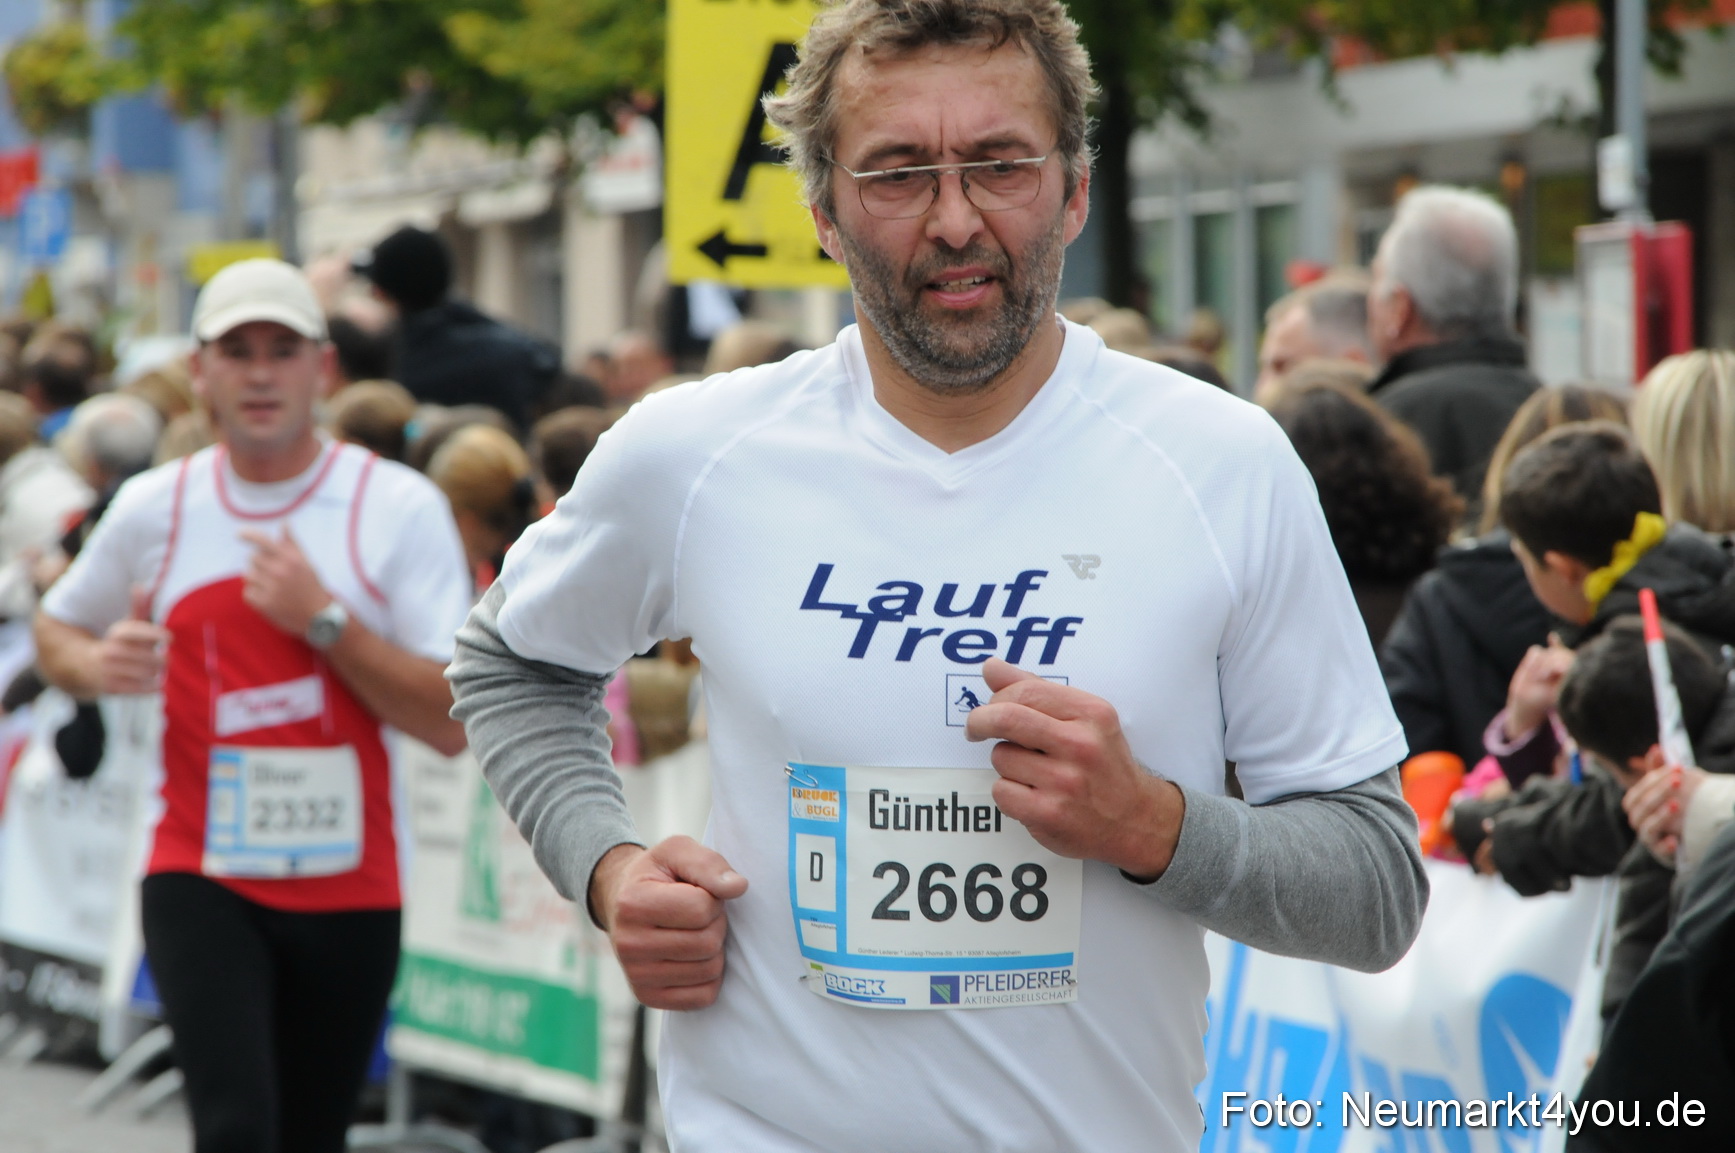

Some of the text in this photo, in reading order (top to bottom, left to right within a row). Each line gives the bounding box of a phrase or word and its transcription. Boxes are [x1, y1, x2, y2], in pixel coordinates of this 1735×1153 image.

[799, 563, 1049, 618] Lauf
[840, 609, 1084, 665] Treff
[252, 797, 342, 832] 2332
[806, 804, 838, 817] BÜGL
[810, 851, 824, 882] D
[870, 861, 1050, 923] 2668
[825, 973, 886, 995] BOCK
[964, 969, 1072, 992] PFLEIDERER
[964, 989, 1073, 1005] AKTIENGESELLSCHAFT
